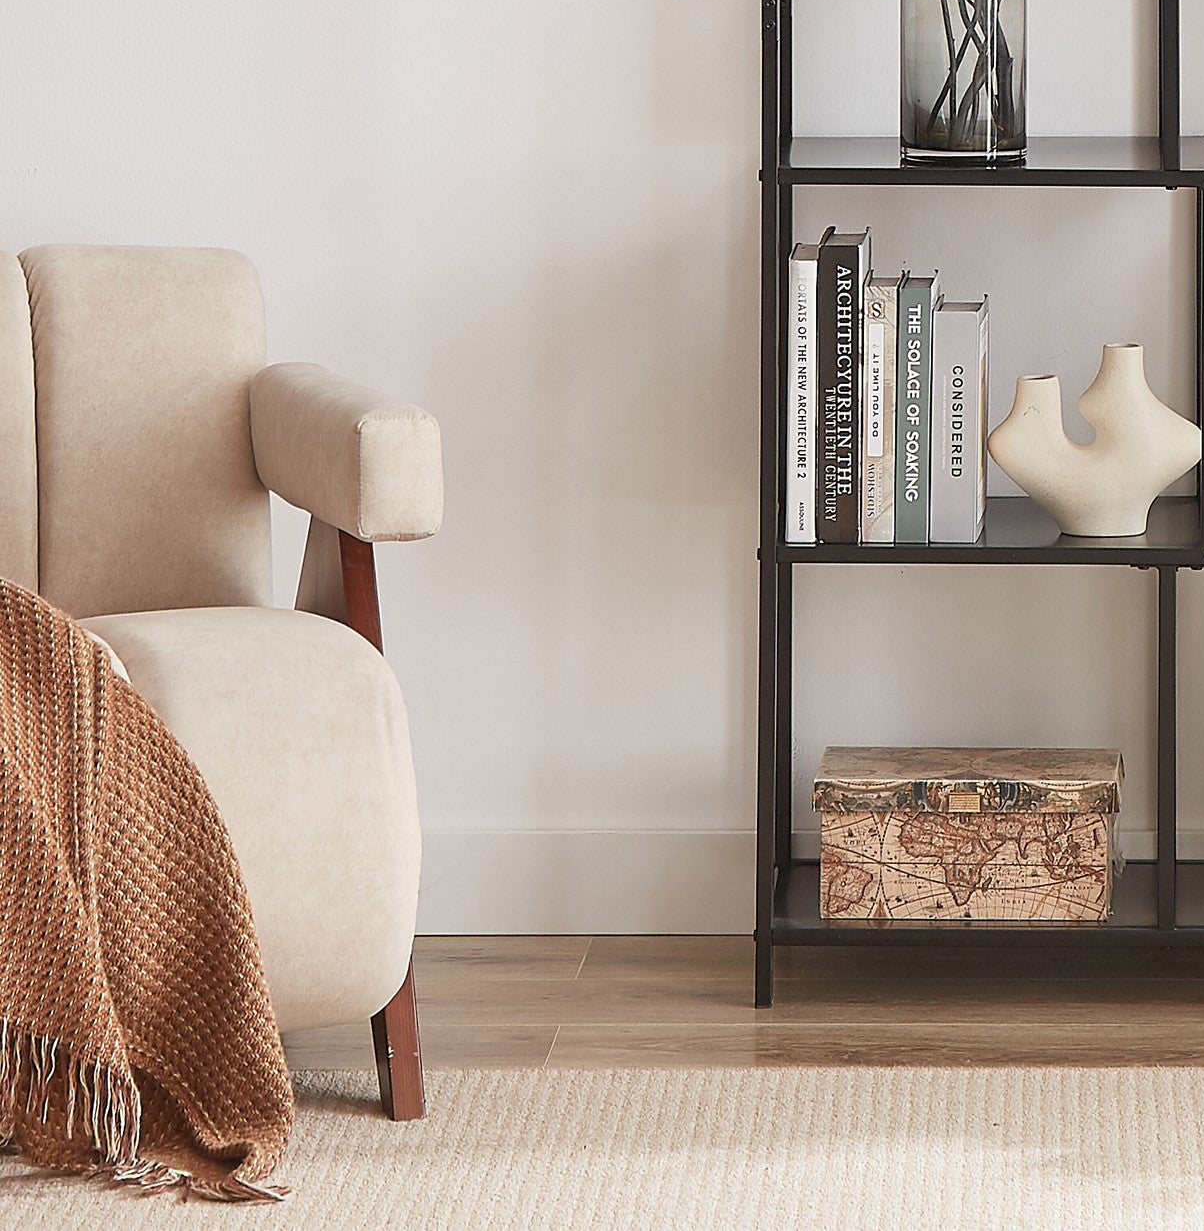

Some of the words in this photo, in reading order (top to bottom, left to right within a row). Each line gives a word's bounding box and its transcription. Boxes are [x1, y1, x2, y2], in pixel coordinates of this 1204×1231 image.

[797, 278, 808, 323] PORTATS
[872, 302, 882, 318] S
[907, 303, 922, 334] THE
[797, 326, 807, 341] OF
[797, 344, 807, 363] THE
[837, 265, 852, 423] ARCHITECYURE
[797, 367, 807, 391] NEW
[872, 353, 879, 364] IT
[906, 339, 921, 399] SOLACE
[797, 395, 807, 469] ARCHITECTURE
[825, 387, 837, 460] TWENTIETH
[872, 421, 879, 438] DO
[906, 403, 920, 426] OF
[951, 365, 964, 478] CONSIDERED
[837, 426, 852, 449] IN
[837, 452, 852, 495] THE
[904, 431, 919, 502] SOAKING
[824, 465, 837, 522] CENTURY
[866, 462, 875, 518] SIDESHOW
